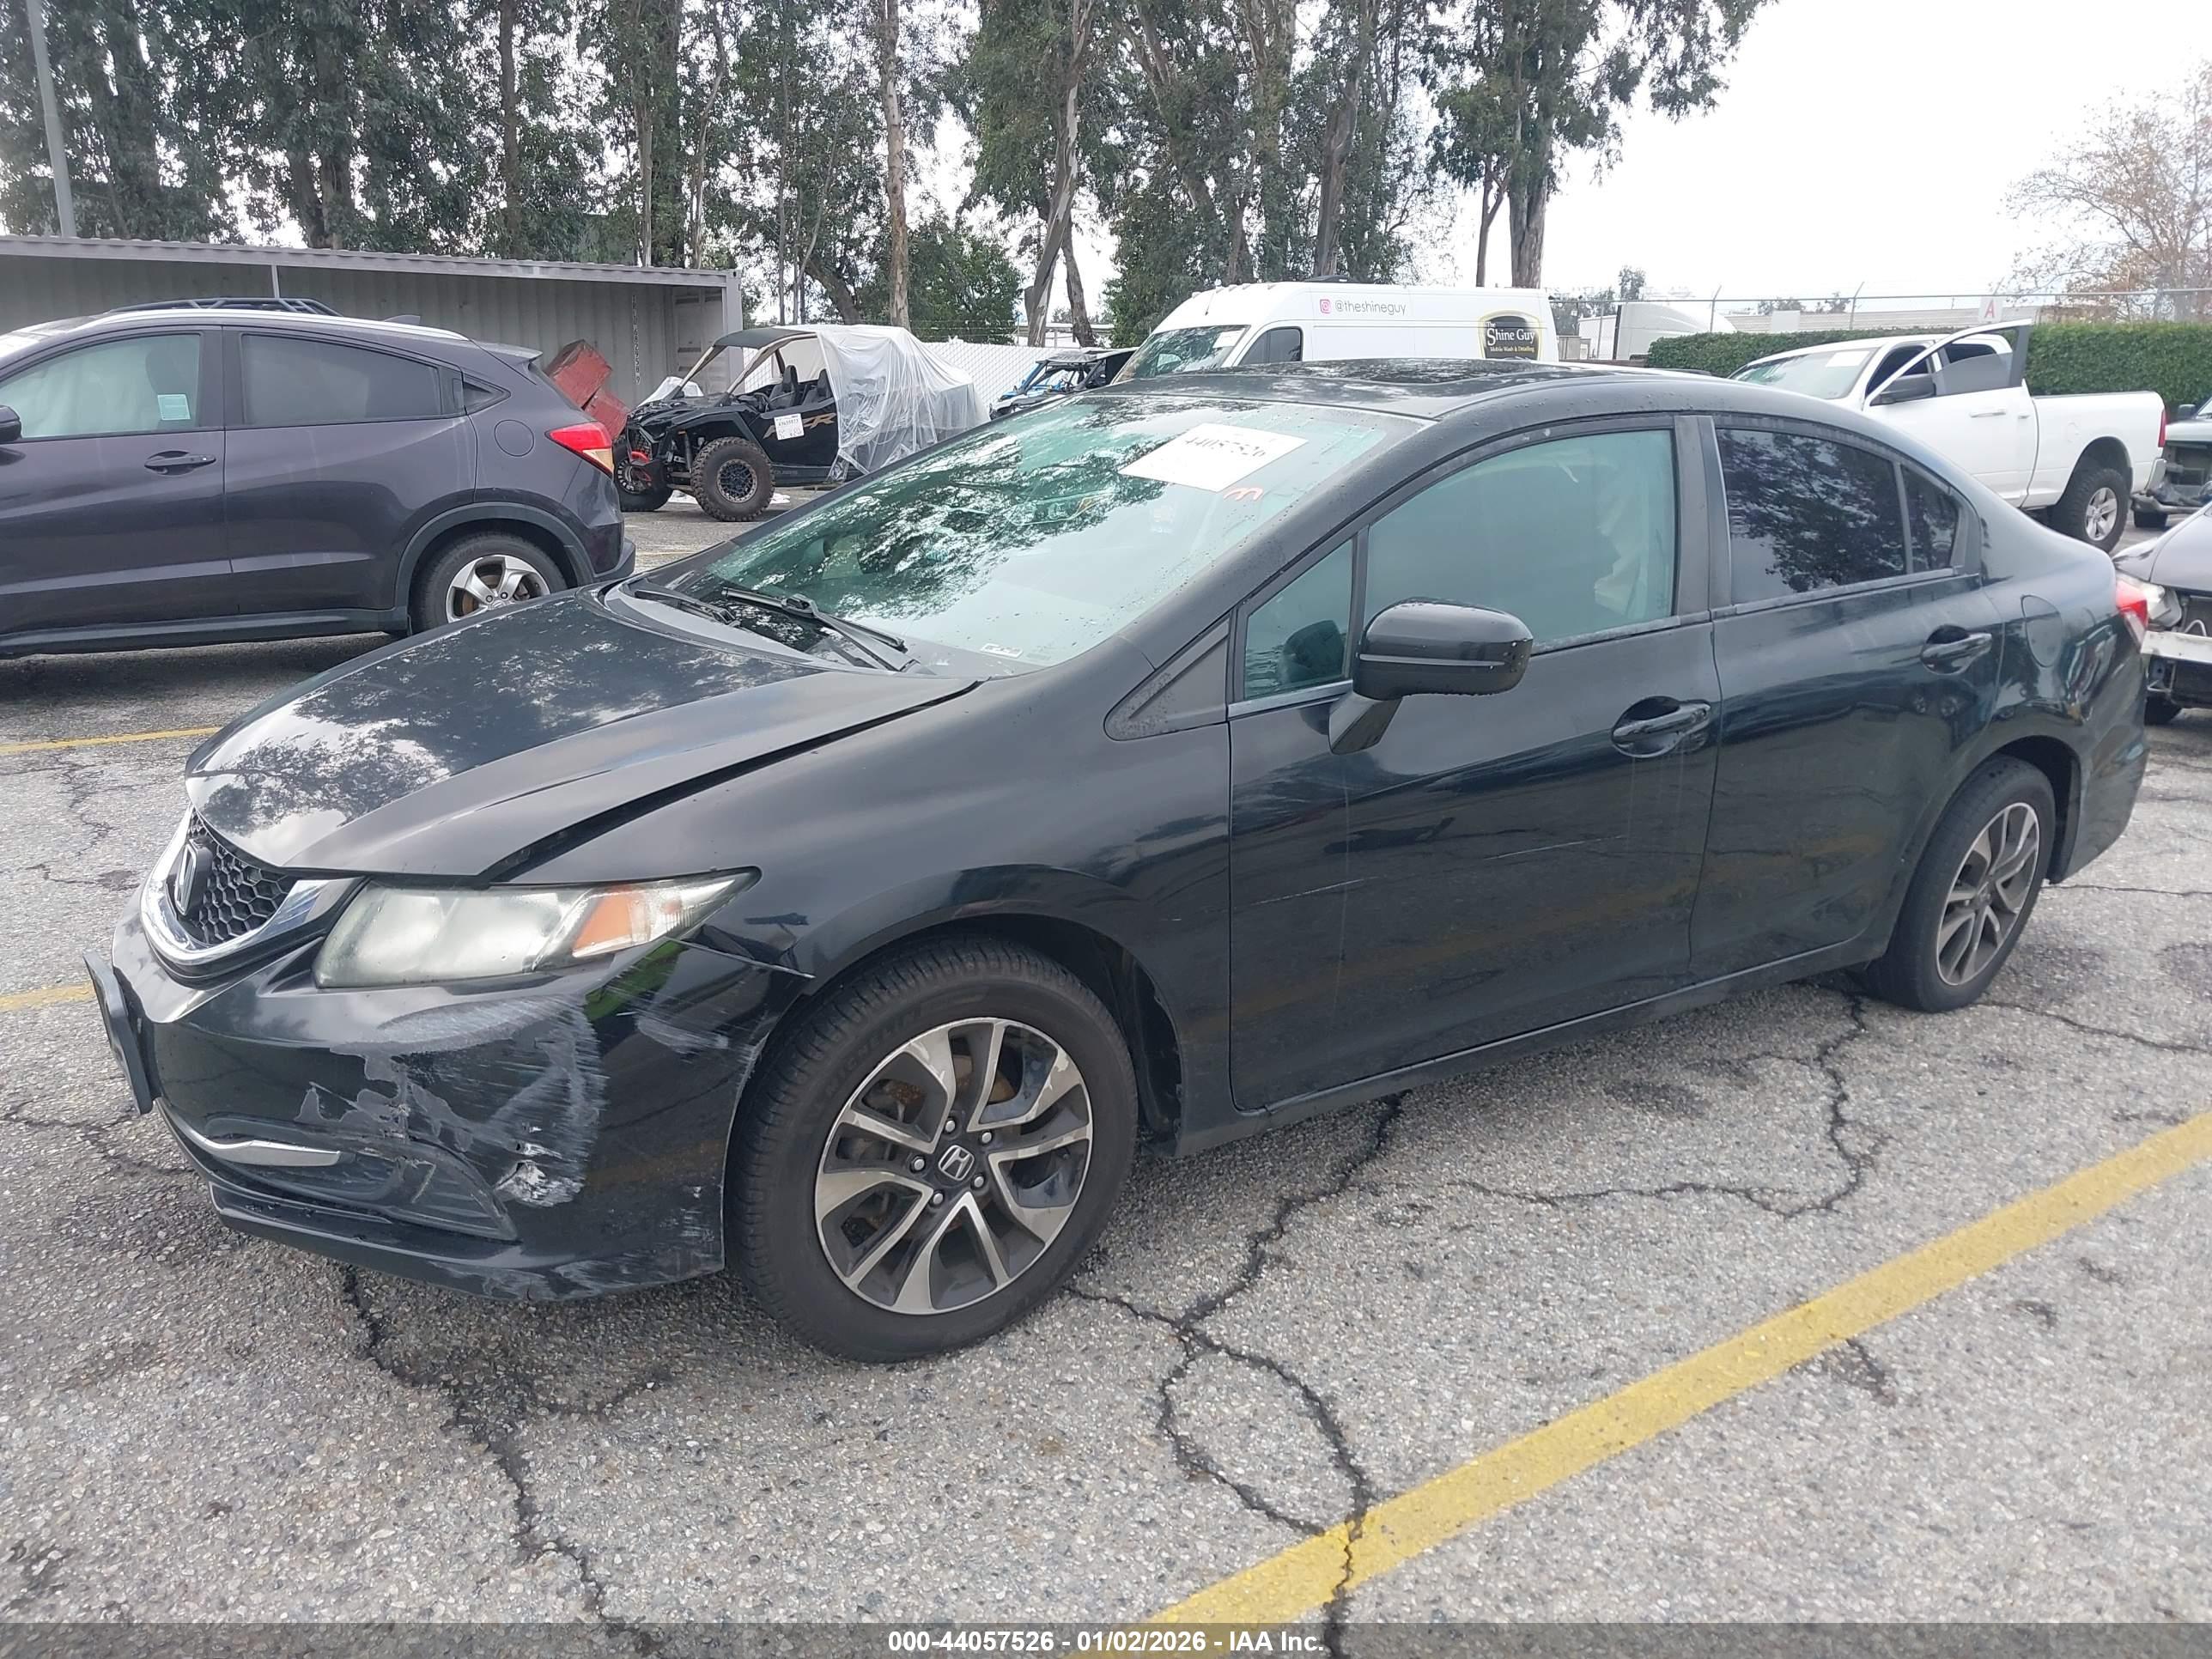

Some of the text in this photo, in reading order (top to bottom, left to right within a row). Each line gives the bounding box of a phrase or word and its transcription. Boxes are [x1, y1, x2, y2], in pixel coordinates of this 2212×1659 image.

[1335, 300, 1407, 315] @theshineguy
[1984, 299, 1996, 318] A
[1486, 328, 1535, 346] Shine Guy
